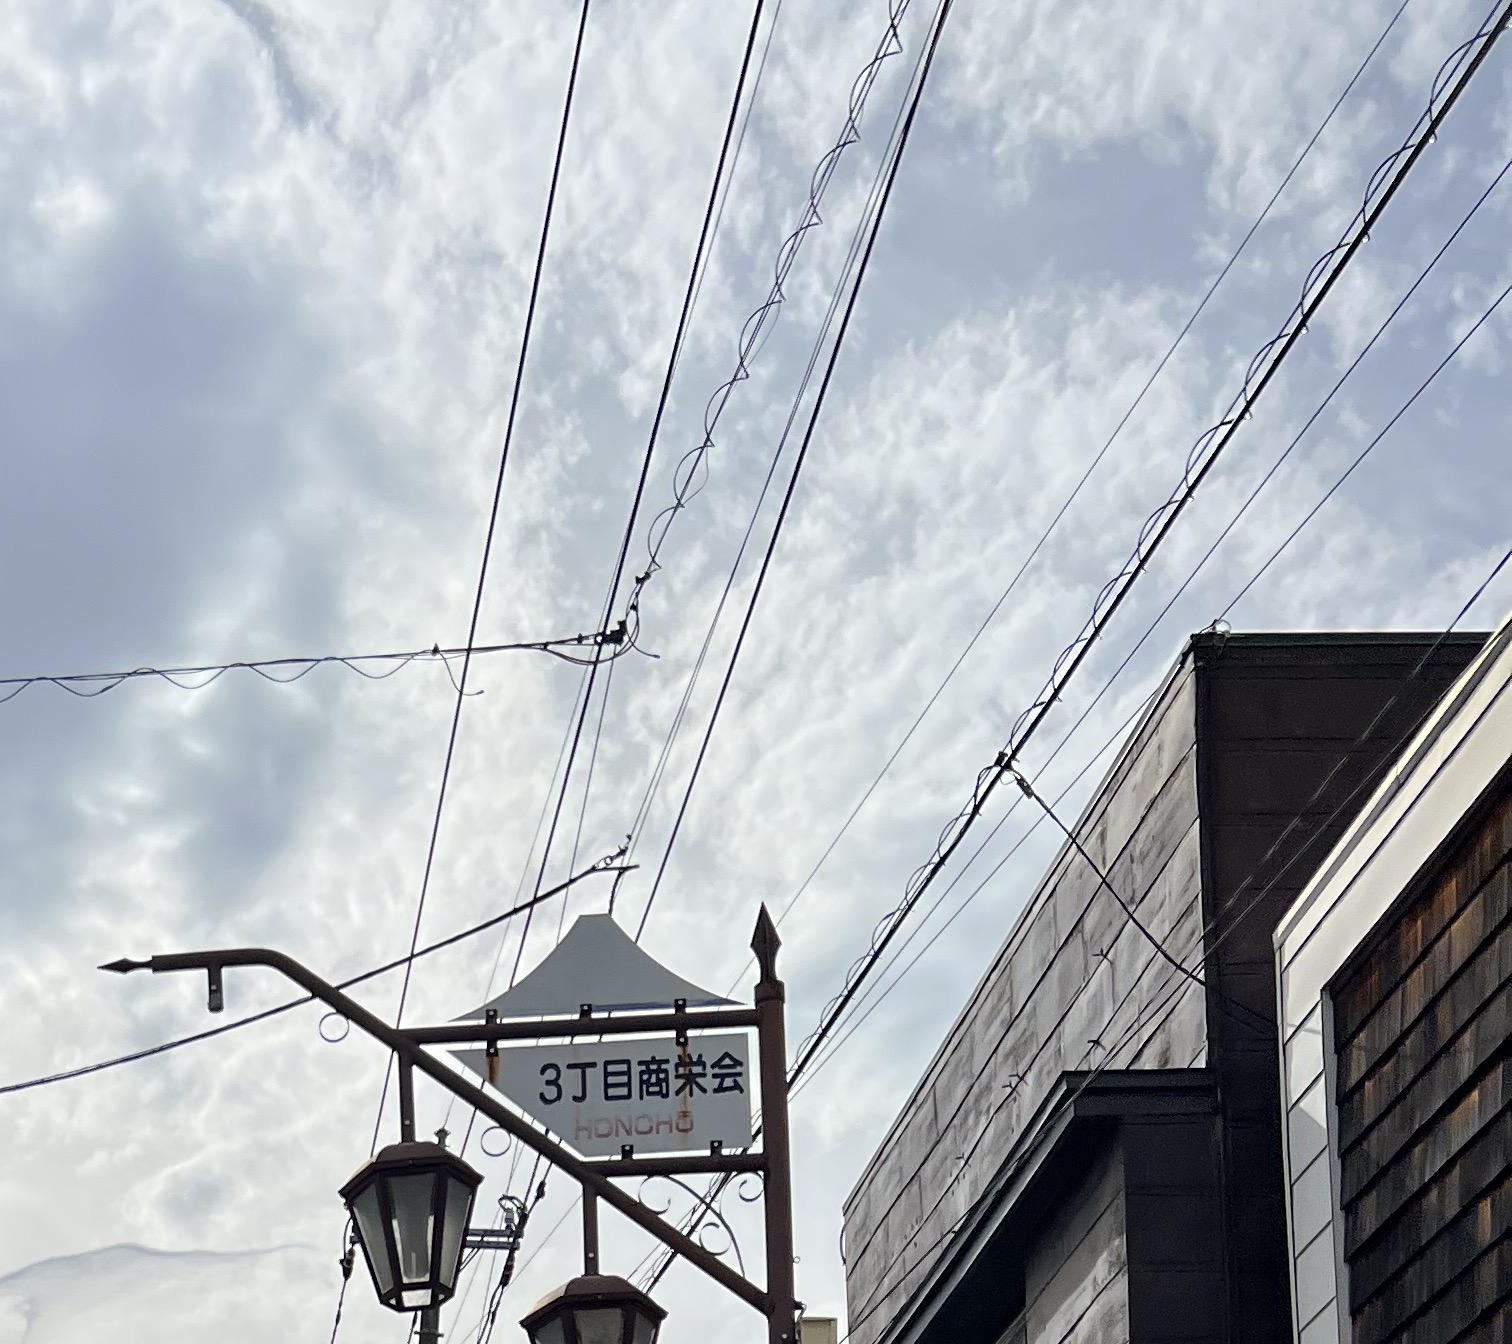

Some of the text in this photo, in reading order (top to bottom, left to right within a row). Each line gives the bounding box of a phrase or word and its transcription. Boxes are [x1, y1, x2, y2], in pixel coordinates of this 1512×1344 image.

[539, 1051, 745, 1105] 3丁目商栄会
